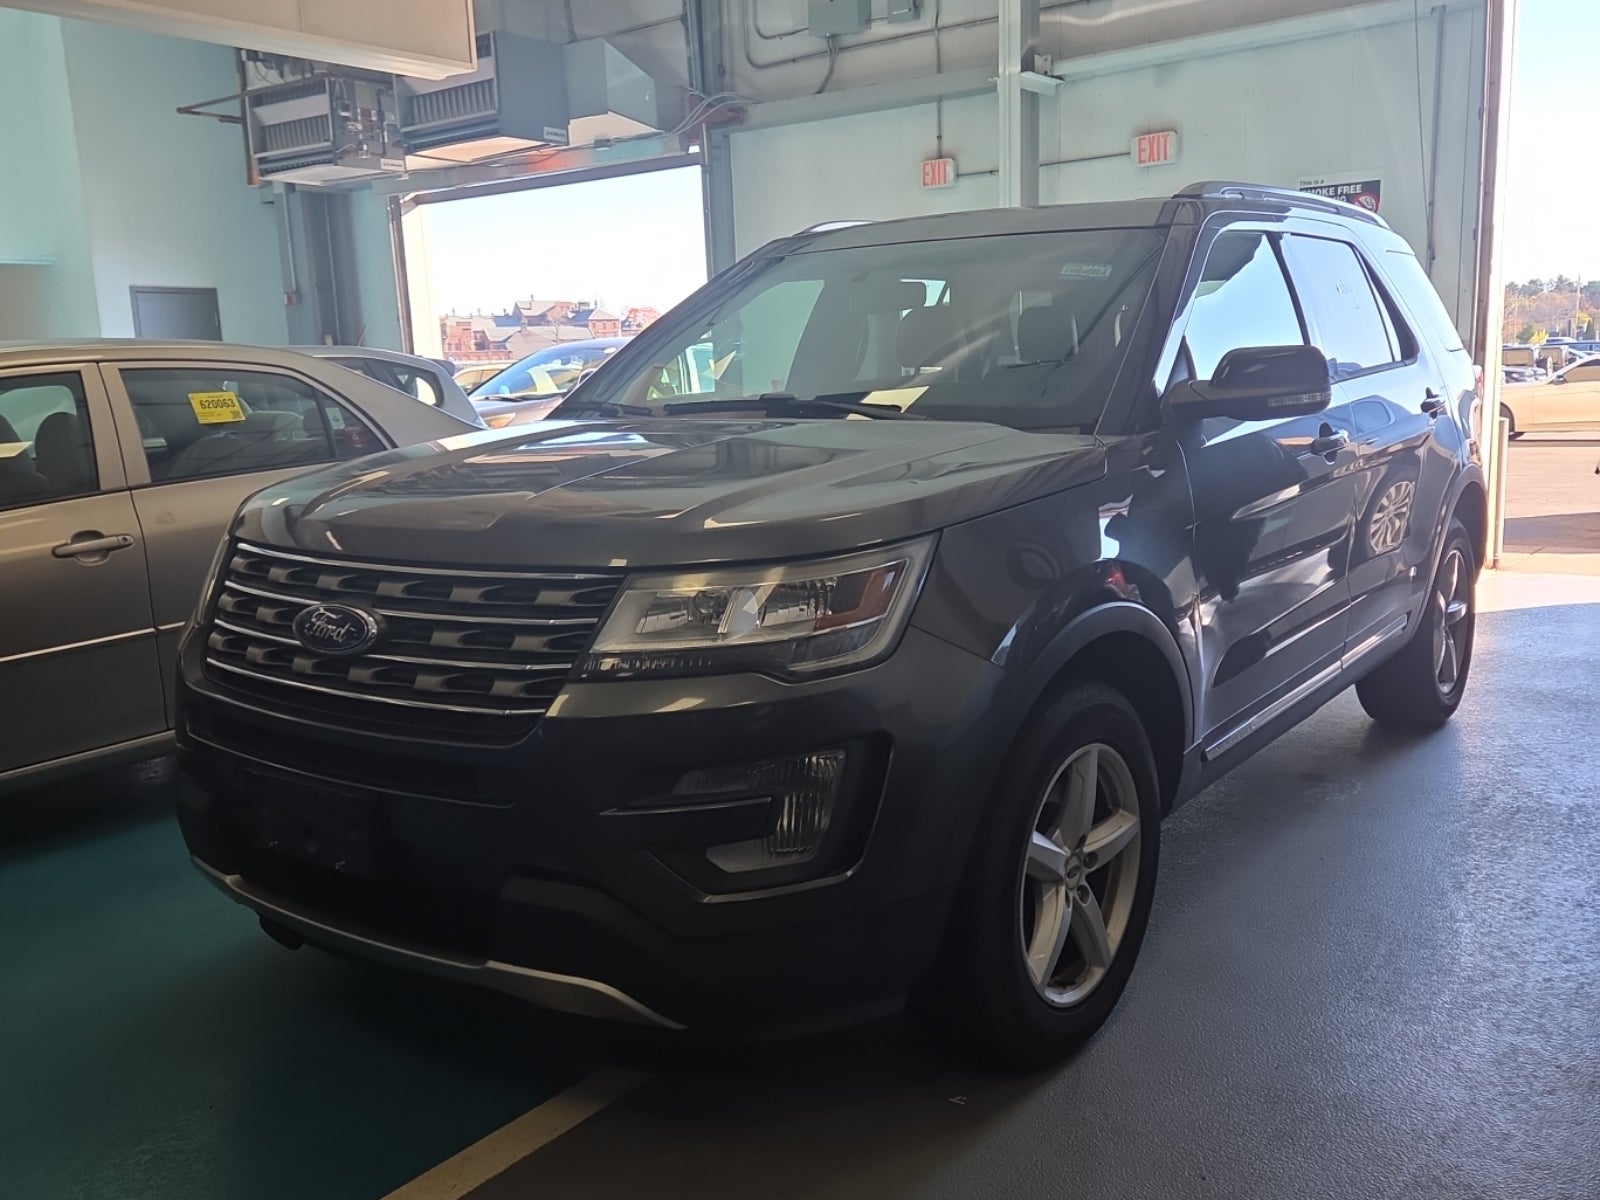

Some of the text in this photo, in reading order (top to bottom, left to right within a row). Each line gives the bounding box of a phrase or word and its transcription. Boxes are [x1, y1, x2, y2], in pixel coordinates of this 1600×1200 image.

[1138, 134, 1169, 164] EXIT
[922, 161, 947, 187] EXIT
[1338, 184, 1363, 195] FREE
[199, 398, 236, 409] 620063
[304, 606, 354, 643] Ford
